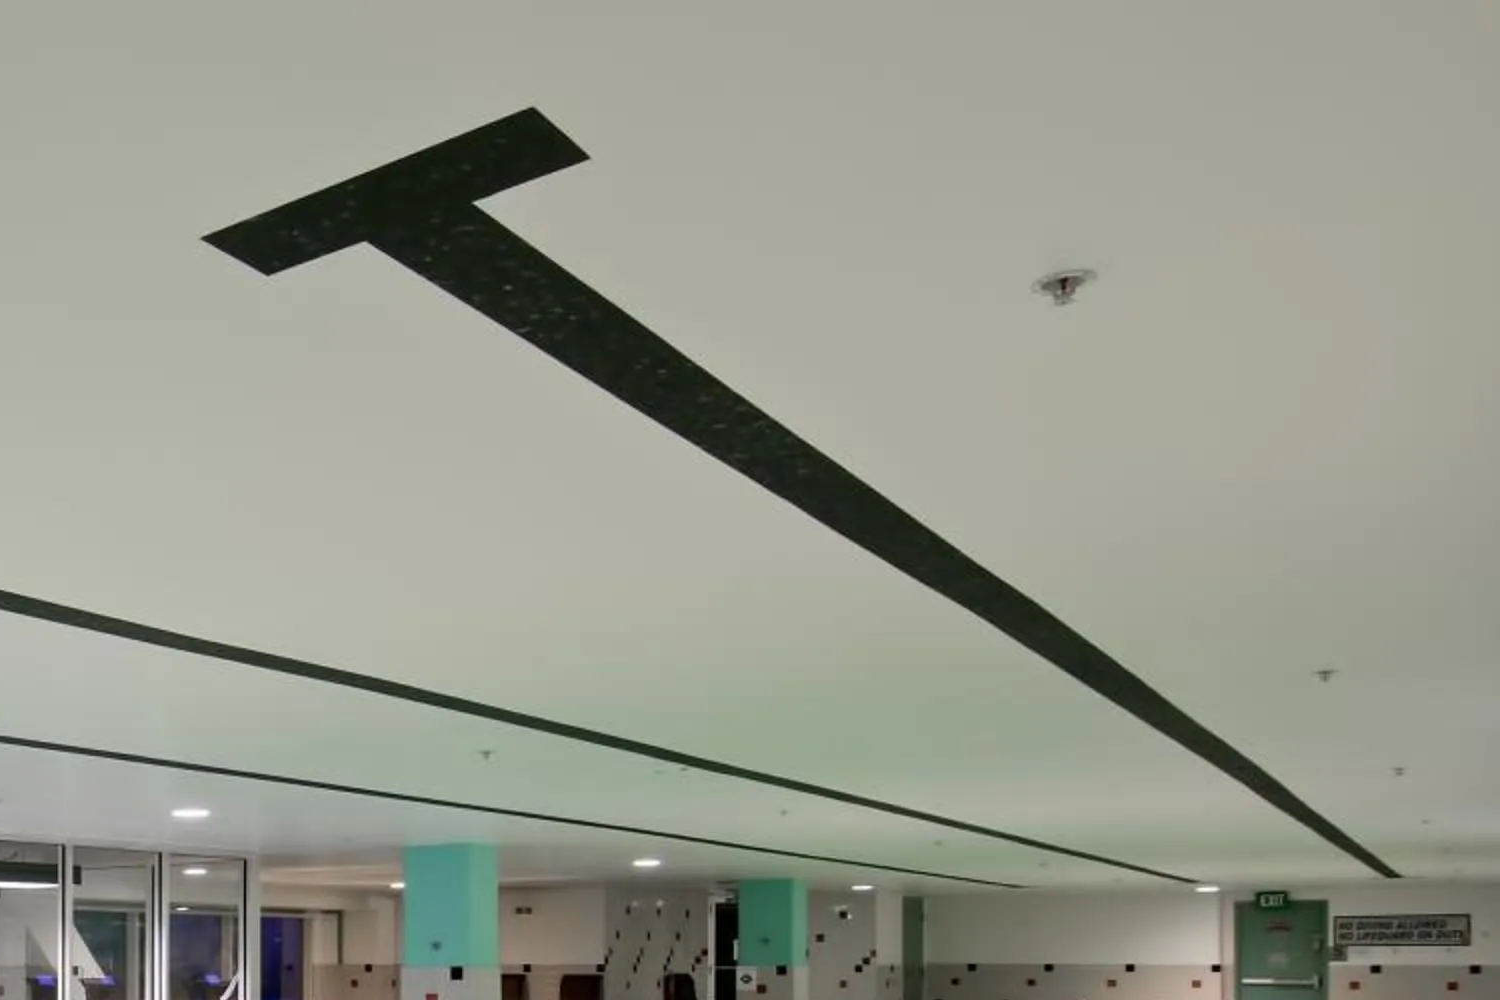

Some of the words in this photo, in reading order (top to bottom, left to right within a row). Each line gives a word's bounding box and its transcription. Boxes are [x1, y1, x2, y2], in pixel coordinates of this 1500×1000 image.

[1260, 893, 1284, 907] EXIT
[1338, 921, 1353, 930] NO
[1397, 919, 1447, 930] ALLOWED
[1338, 931, 1353, 941] NO
[1356, 931, 1414, 941] LIFEGUARD
[1417, 930, 1432, 940] ON
[1436, 930, 1463, 940] DUTY
